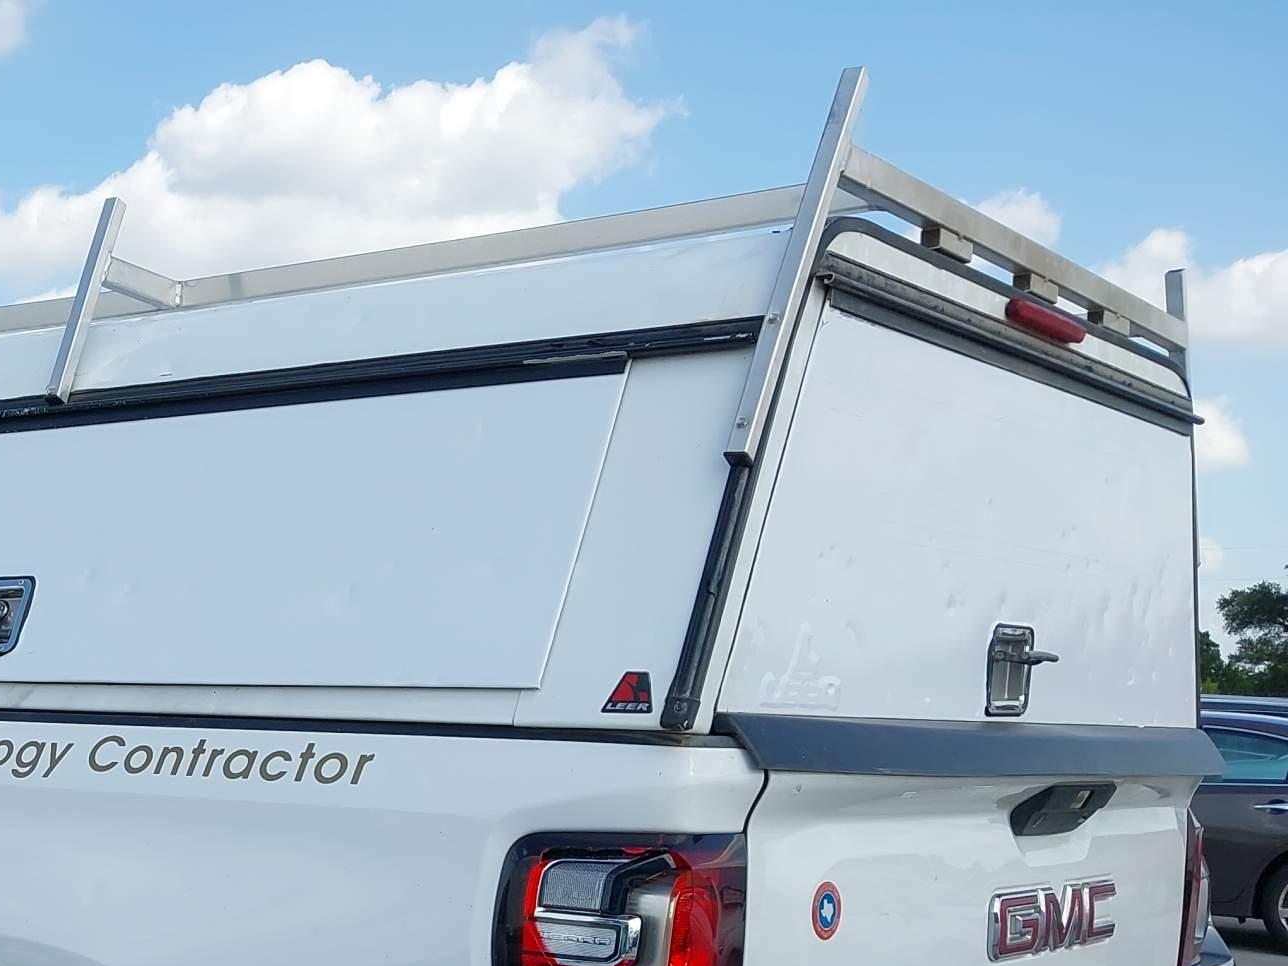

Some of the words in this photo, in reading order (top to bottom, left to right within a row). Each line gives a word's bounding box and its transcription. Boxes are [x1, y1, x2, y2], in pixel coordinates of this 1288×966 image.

[605, 702, 650, 711] LEER
[88, 735, 378, 786] Contractor
[987, 880, 1116, 962] GMC
